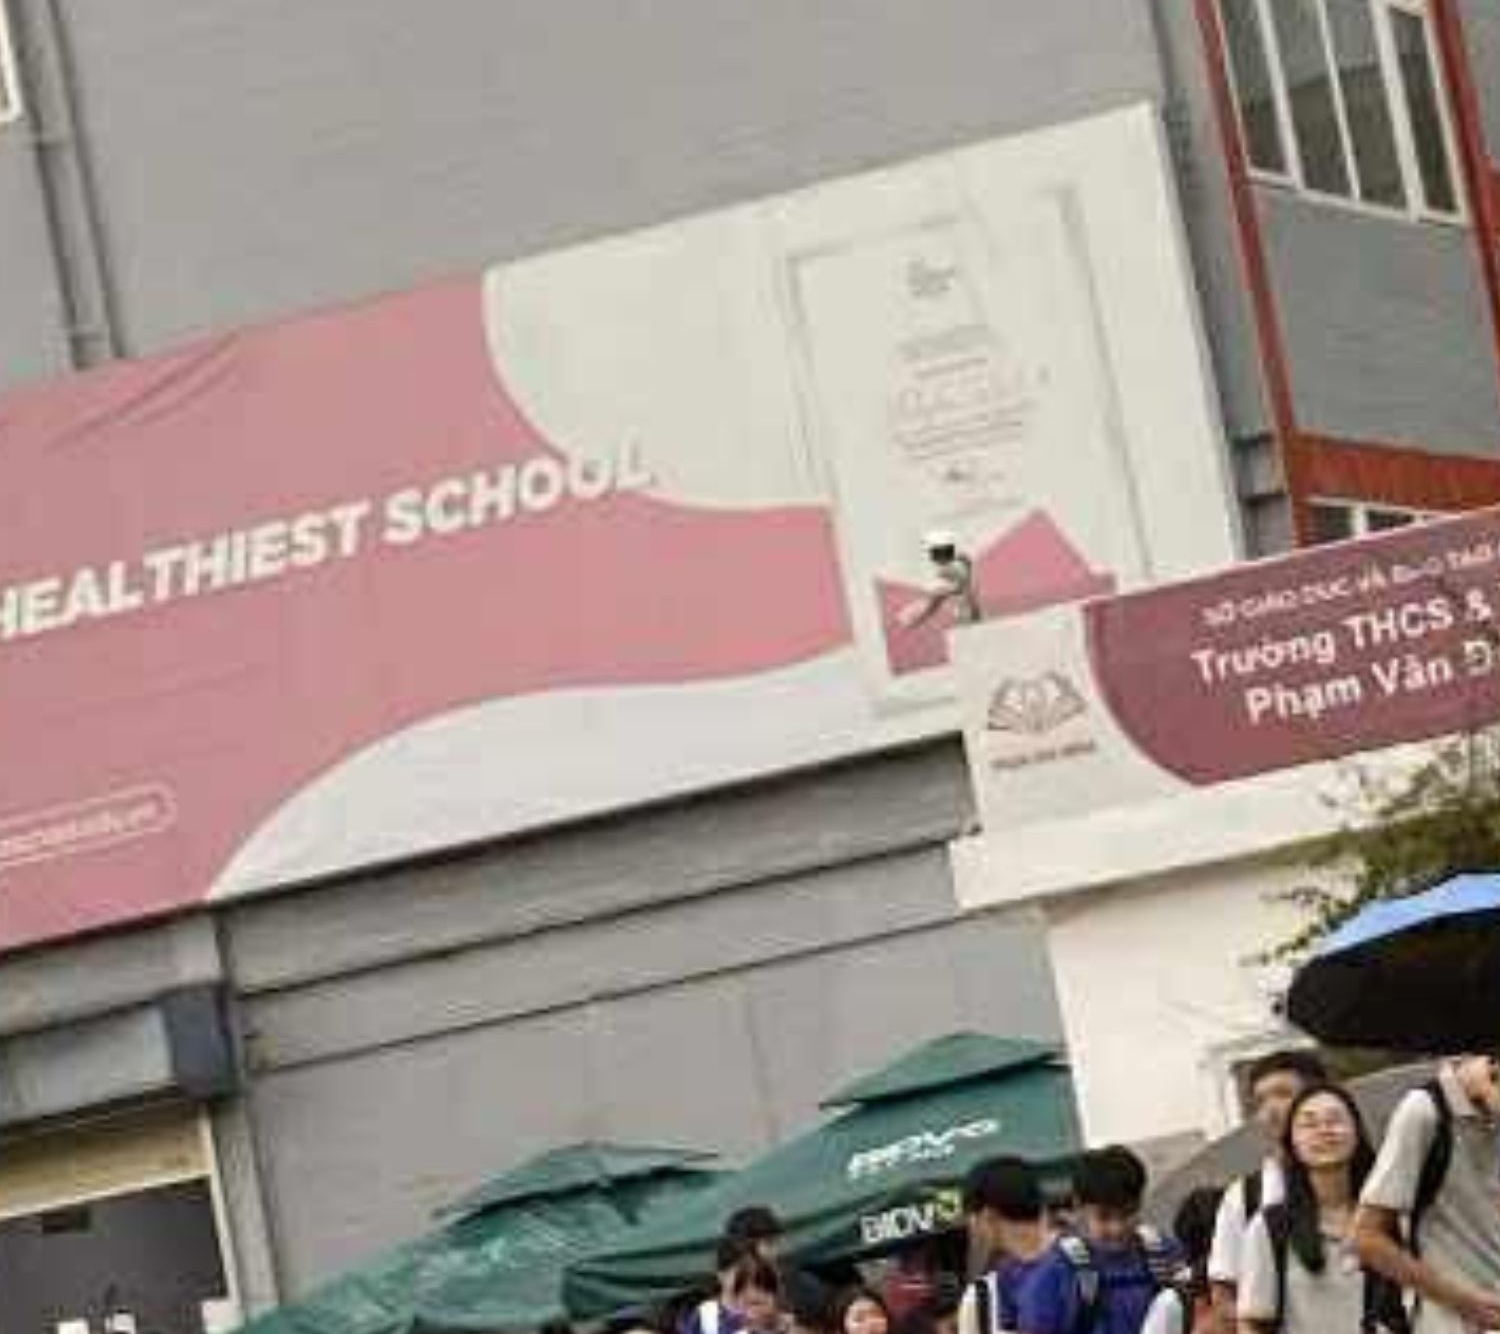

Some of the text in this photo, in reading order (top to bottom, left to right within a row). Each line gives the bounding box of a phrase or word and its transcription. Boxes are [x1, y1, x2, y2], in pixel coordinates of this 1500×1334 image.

[383, 427, 652, 544] SCHOOL
[1190, 630, 1337, 686] Trường
[1342, 598, 1454, 648] THCS
[1465, 589, 1493, 622] &
[1245, 674, 1362, 725] Phạm
